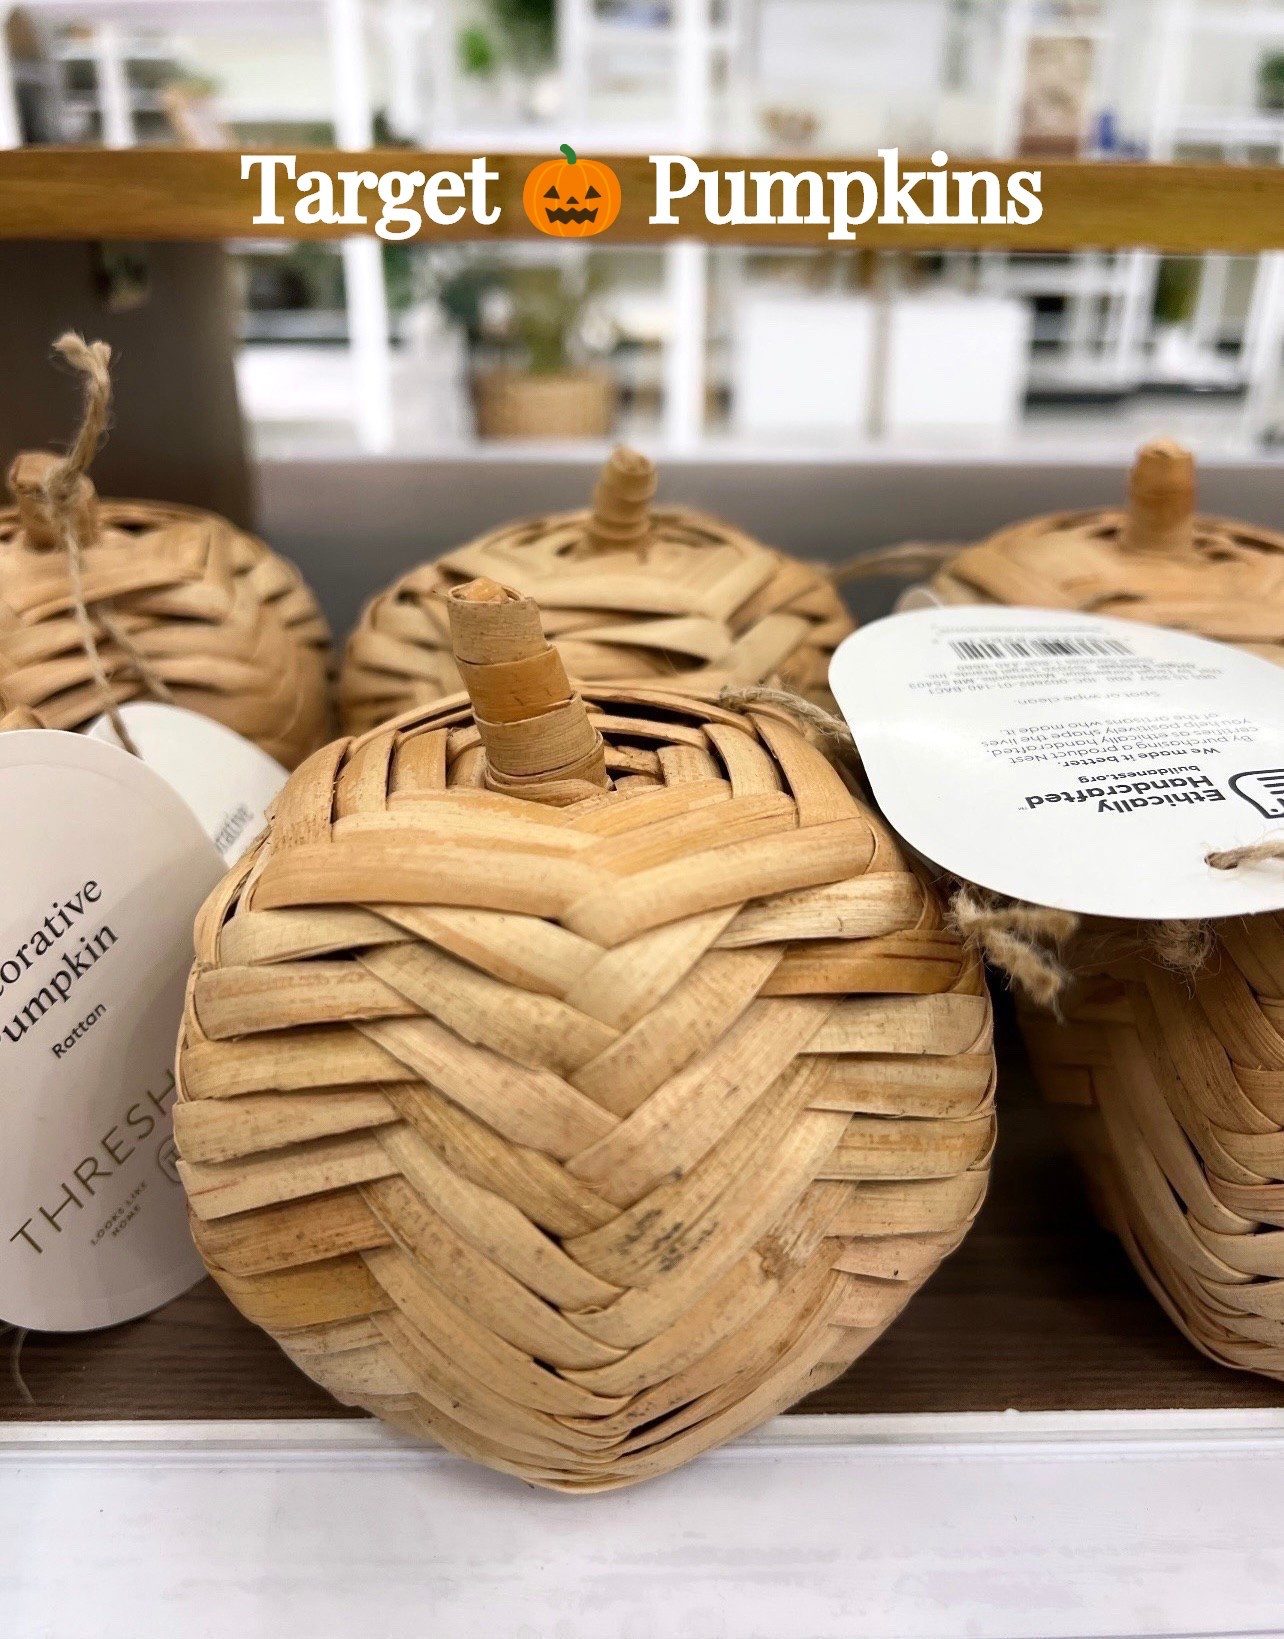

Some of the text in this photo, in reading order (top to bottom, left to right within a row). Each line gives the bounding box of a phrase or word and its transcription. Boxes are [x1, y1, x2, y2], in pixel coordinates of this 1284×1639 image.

[1068, 721, 1102, 729] who
[1105, 716, 1169, 727] artisans
[981, 718, 1251, 747] you help positively shape the lives
[1019, 724, 1064, 734] made
[1193, 727, 1259, 737] certifies
[1101, 732, 1169, 744] ethically
[1136, 736, 1229, 749] purchasing
[1233, 735, 1254, 743] By
[986, 739, 1098, 757] handcrafted.
[1050, 745, 1119, 758] product
[1008, 754, 1048, 764] Nest
[1057, 756, 1120, 767] better.
[1121, 754, 1136, 762] it
[1137, 750, 1188, 760] made
[1078, 766, 1201, 784] buildanest.org
[1098, 789, 1226, 813] Ethically
[0, 925, 119, 1043] umpkin
[52, 1003, 107, 1059] Rattan
[10, 1069, 176, 1254] THRESH
[90, 1180, 148, 1246] LOOKS LIKE
[112, 1205, 142, 1238] HOME
